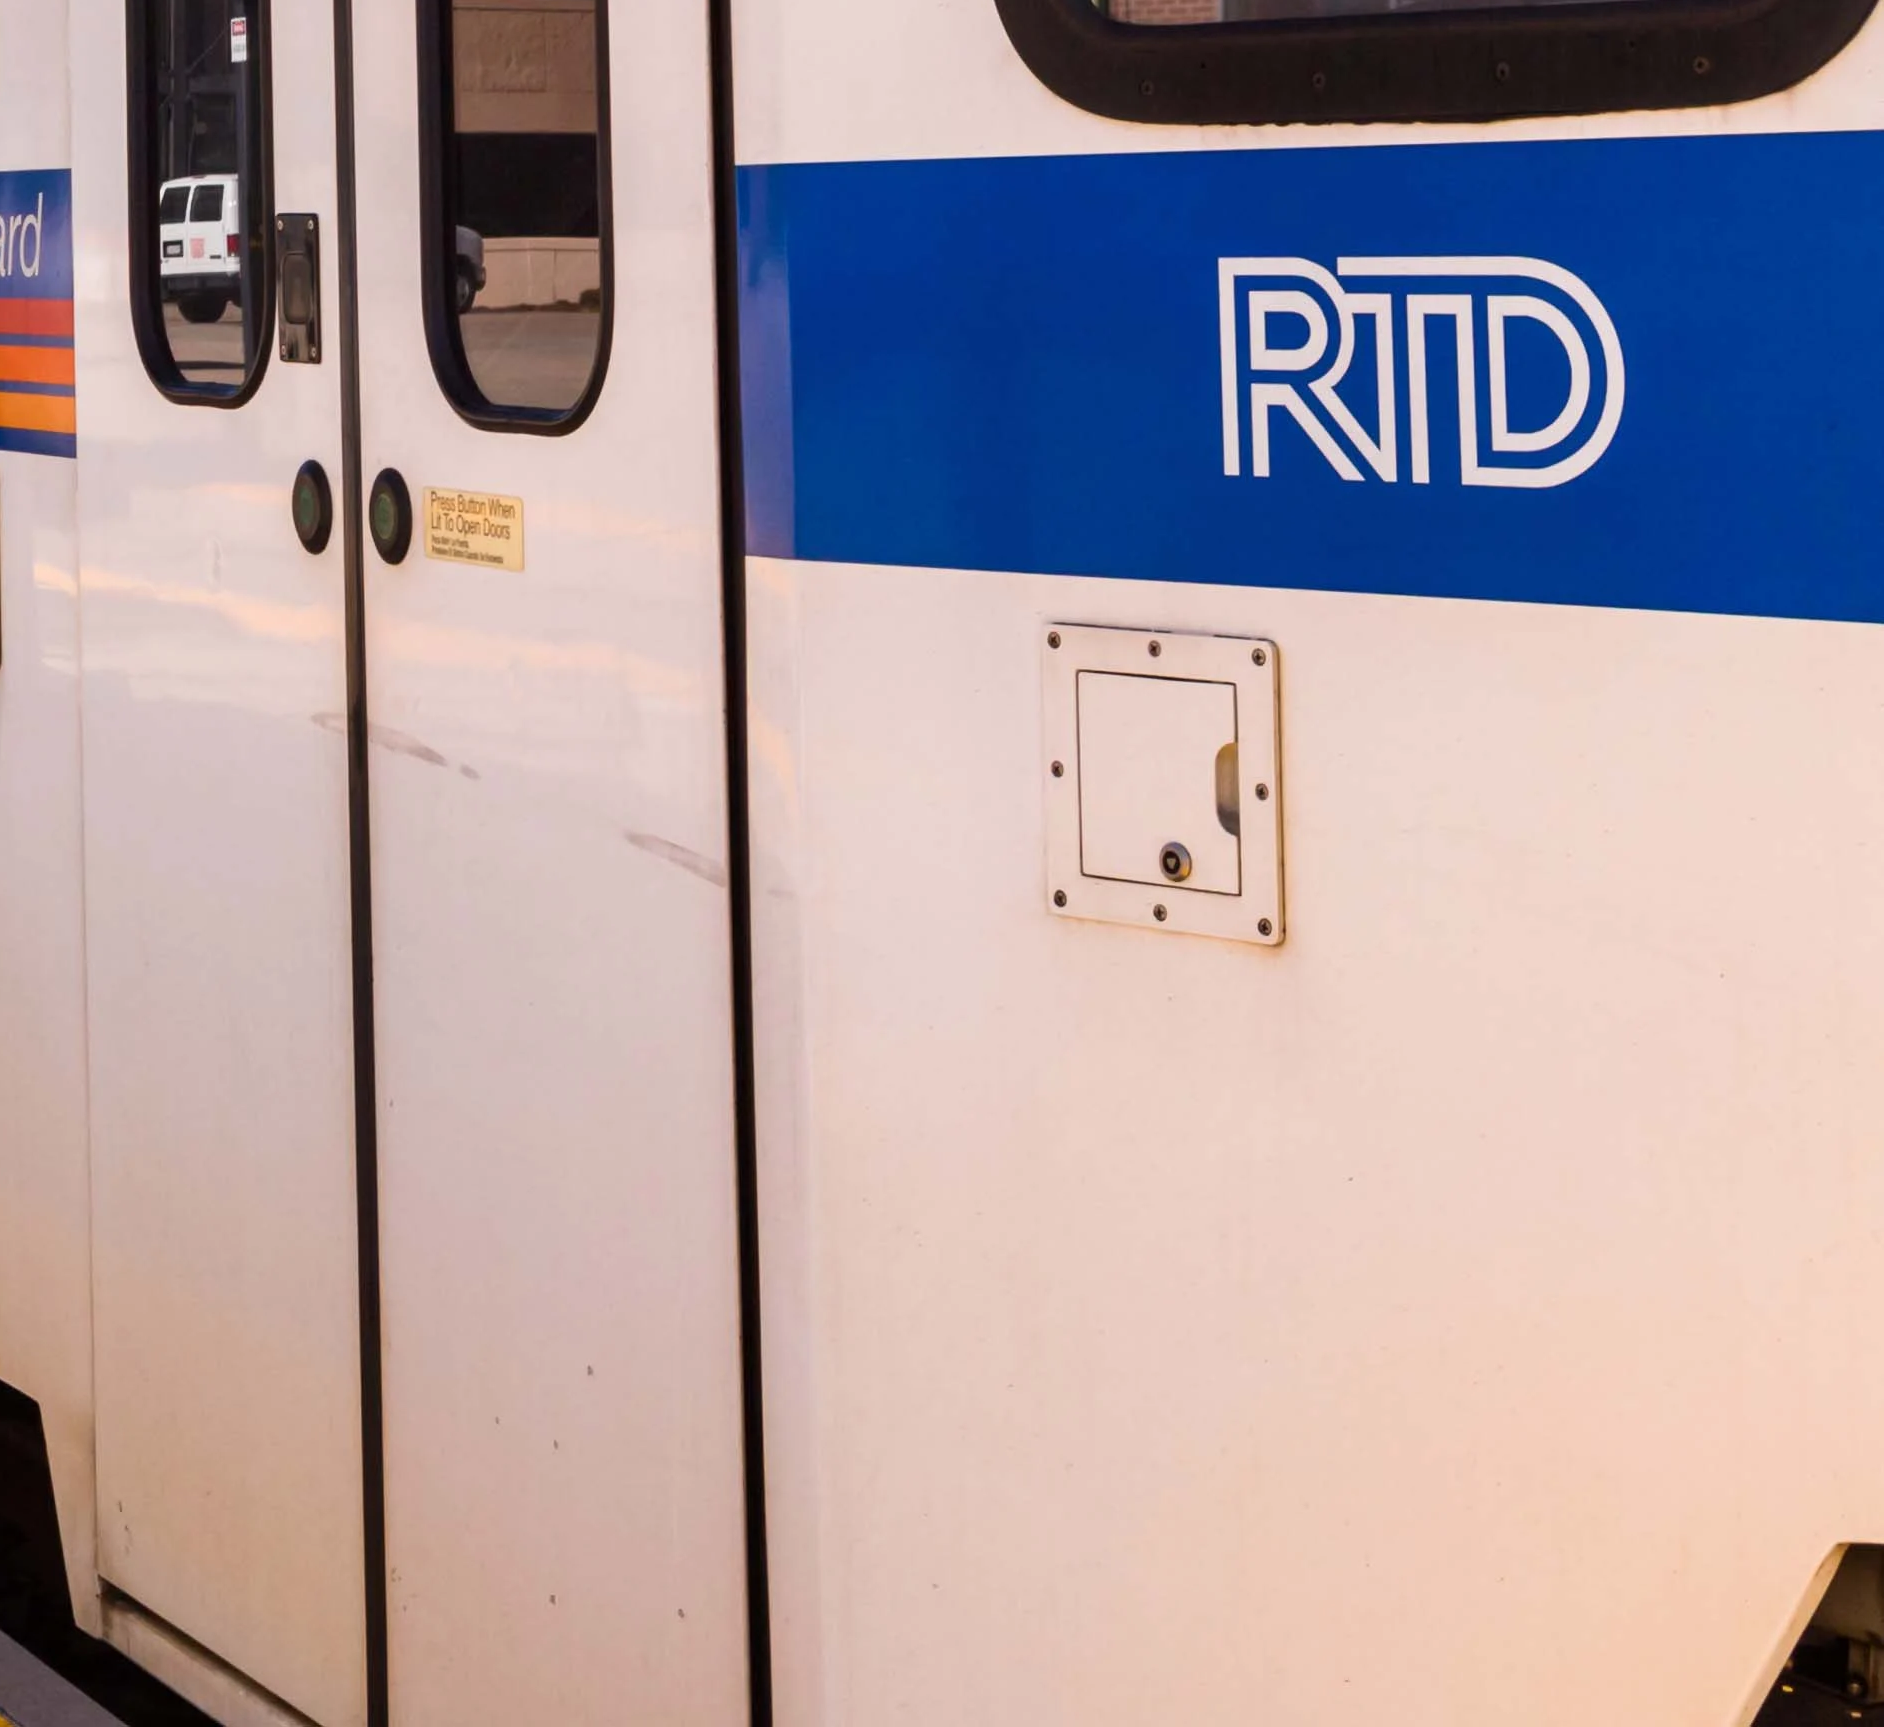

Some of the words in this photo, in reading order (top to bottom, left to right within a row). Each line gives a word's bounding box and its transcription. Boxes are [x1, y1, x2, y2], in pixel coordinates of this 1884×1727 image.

[1217, 255, 1626, 489] RTD
[430, 490, 456, 512] Press
[457, 493, 486, 515] Button
[487, 497, 516, 519] When
[431, 511, 441, 530] Lit
[442, 512, 454, 532] To
[455, 514, 482, 538] Open
[483, 517, 510, 540] Doors
